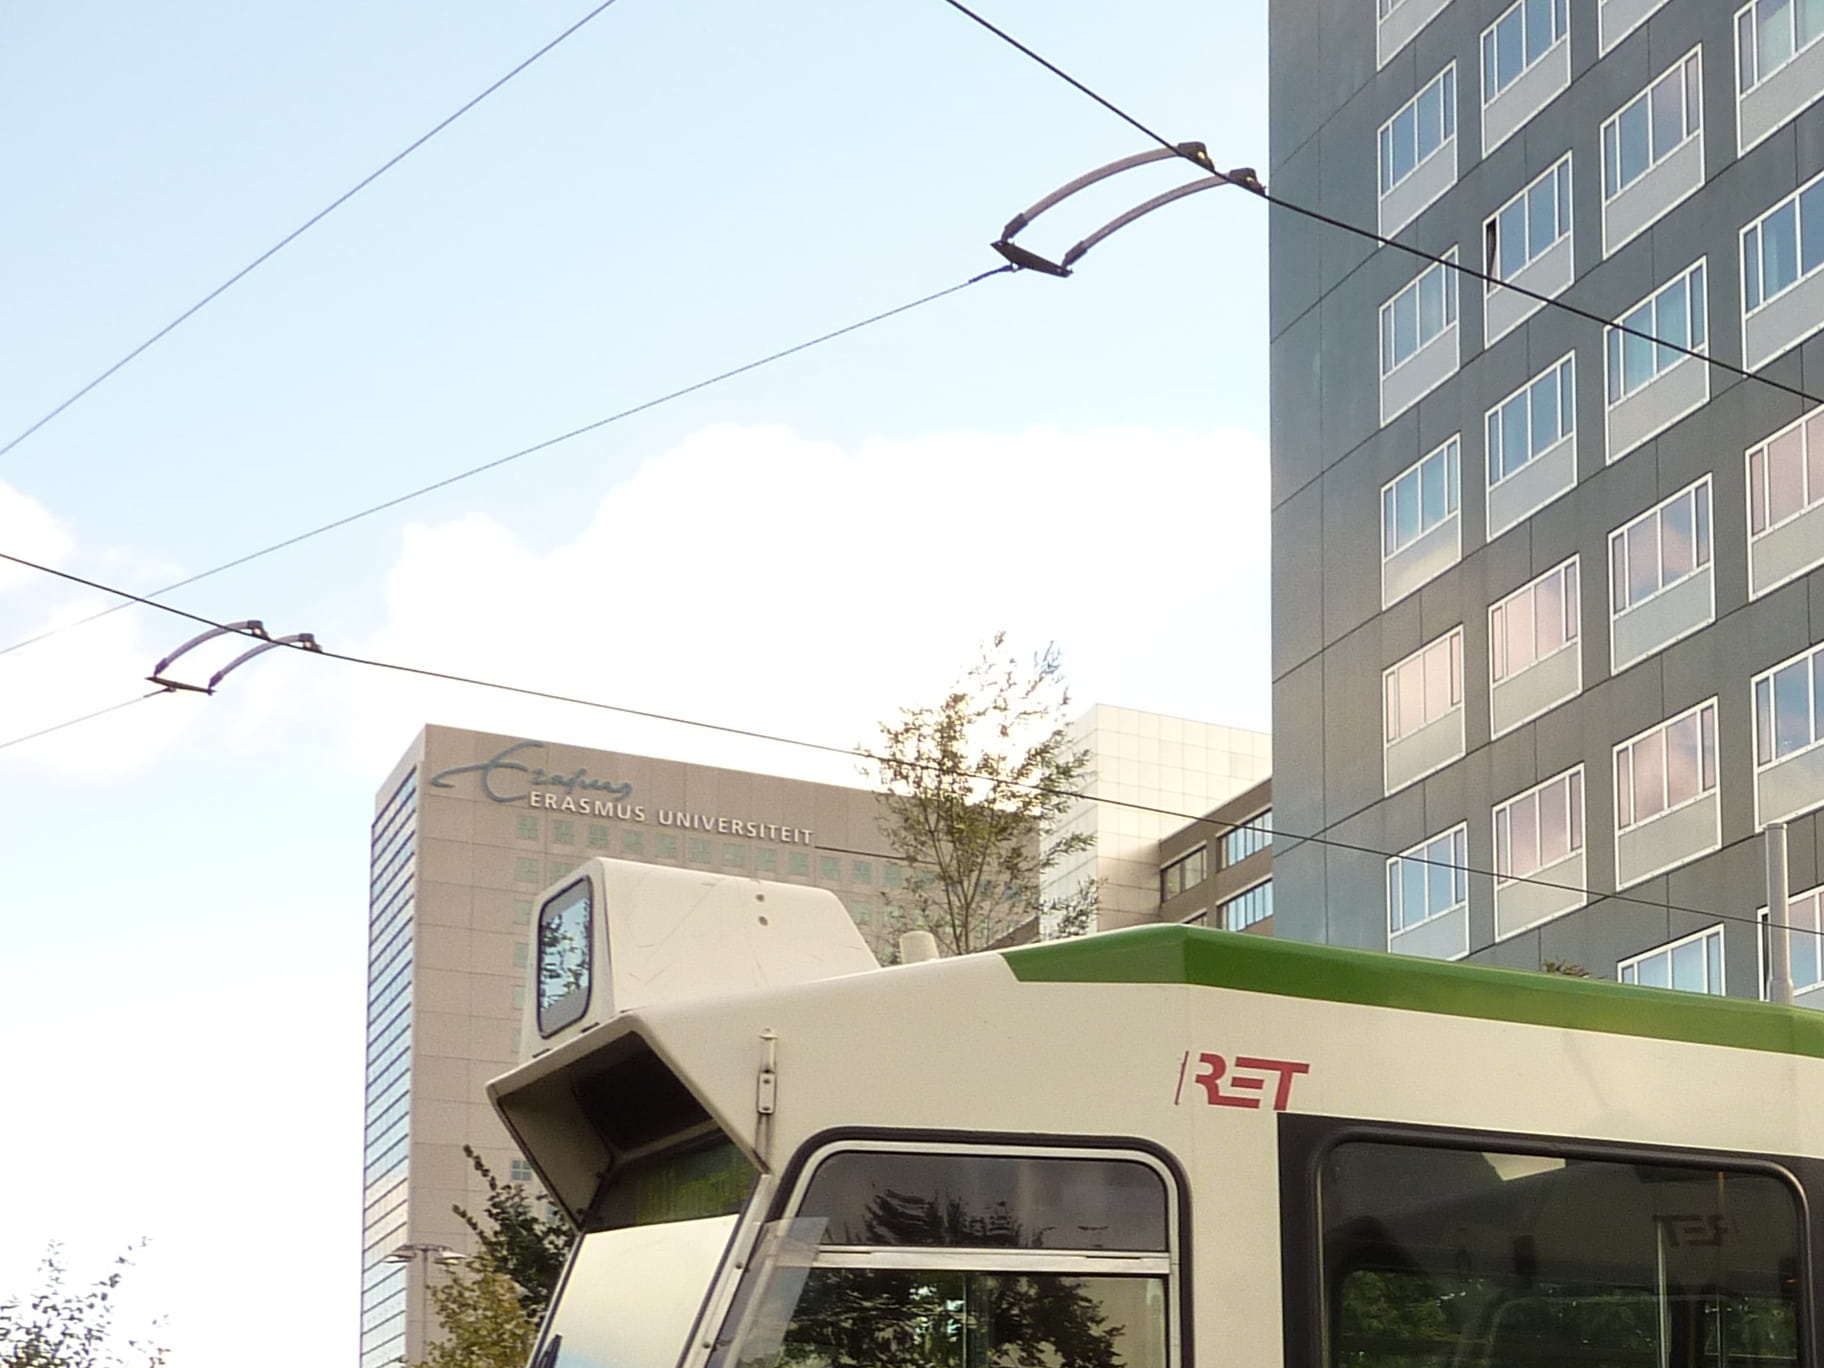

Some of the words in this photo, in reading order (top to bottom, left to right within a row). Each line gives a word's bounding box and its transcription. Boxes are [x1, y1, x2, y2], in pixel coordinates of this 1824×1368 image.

[530, 791, 646, 822] ERASMUS
[658, 809, 814, 845] UNIVERSITEIT
[1195, 1052, 1310, 1111] RET
